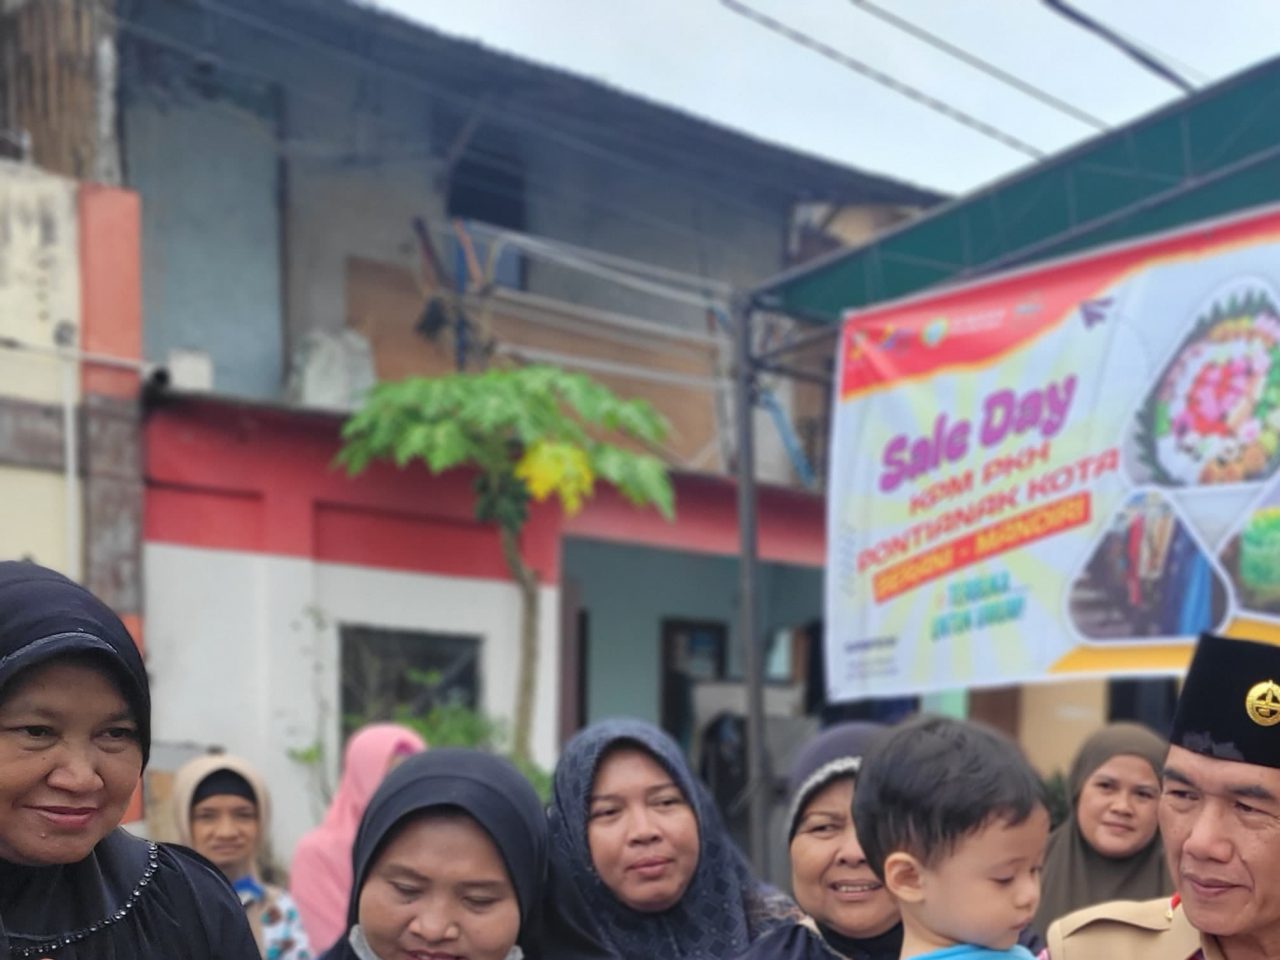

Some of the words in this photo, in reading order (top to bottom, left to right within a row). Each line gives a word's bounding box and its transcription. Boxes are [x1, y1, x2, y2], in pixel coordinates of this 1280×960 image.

[879, 412, 971, 492] Sale
[978, 373, 1078, 448] Day
[909, 469, 974, 516] KPM
[981, 441, 1051, 485] PKH
[856, 486, 1018, 574] PONTIANAK
[1027, 448, 1120, 501] KOTA
